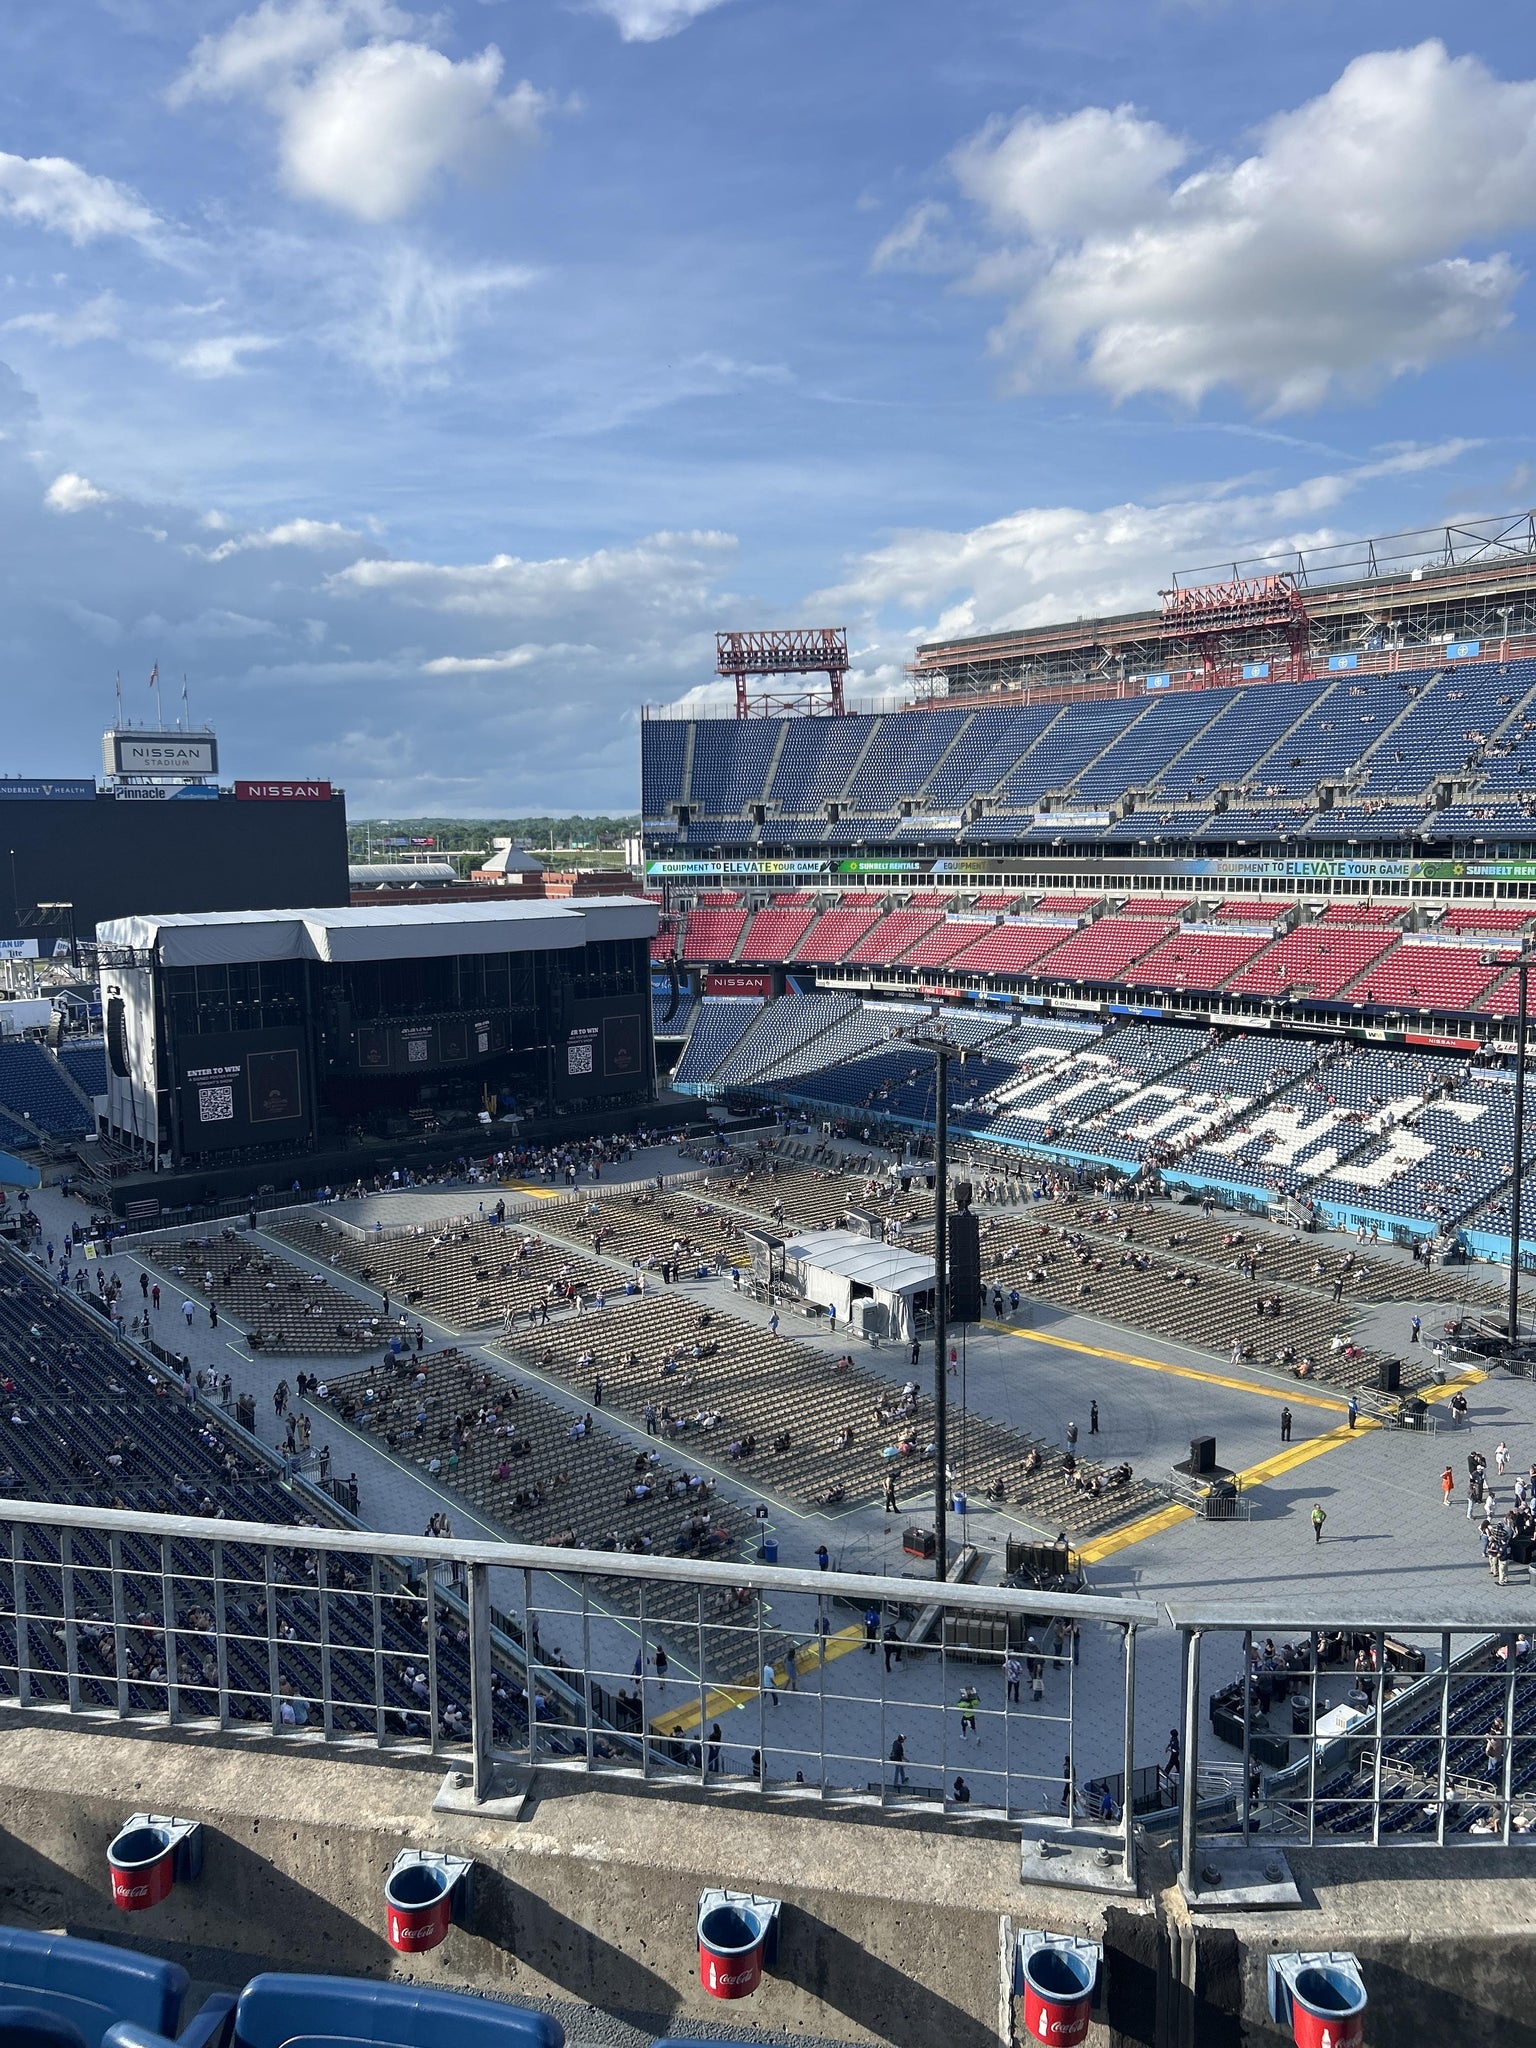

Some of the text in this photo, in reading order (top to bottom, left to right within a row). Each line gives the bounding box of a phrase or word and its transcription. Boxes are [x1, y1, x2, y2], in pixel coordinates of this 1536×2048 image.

[132, 748, 200, 758] NISSAN
[116, 787, 166, 799] Pinnacle
[248, 786, 320, 797] NISSAN
[662, 862, 819, 873] EQUIPMENT TO ELEVATE YOUR GAME
[858, 862, 889, 870] SUNBELT
[943, 861, 986, 870] EQUIPMENT
[1217, 862, 1410, 875] EQUIPMENT TO ELEVATE YOUR GAME
[1466, 866, 1513, 875] SUNBELT
[14, 940, 25, 948] UP
[8, 949, 23, 958] Lite
[714, 978, 763, 987] NISSAN
[587, 1026, 599, 1034] WIN
[1428, 1038, 1457, 1046] NISSAN
[187, 1065, 241, 1077] ENTER TO WIN
[759, 1510, 765, 1518] F
